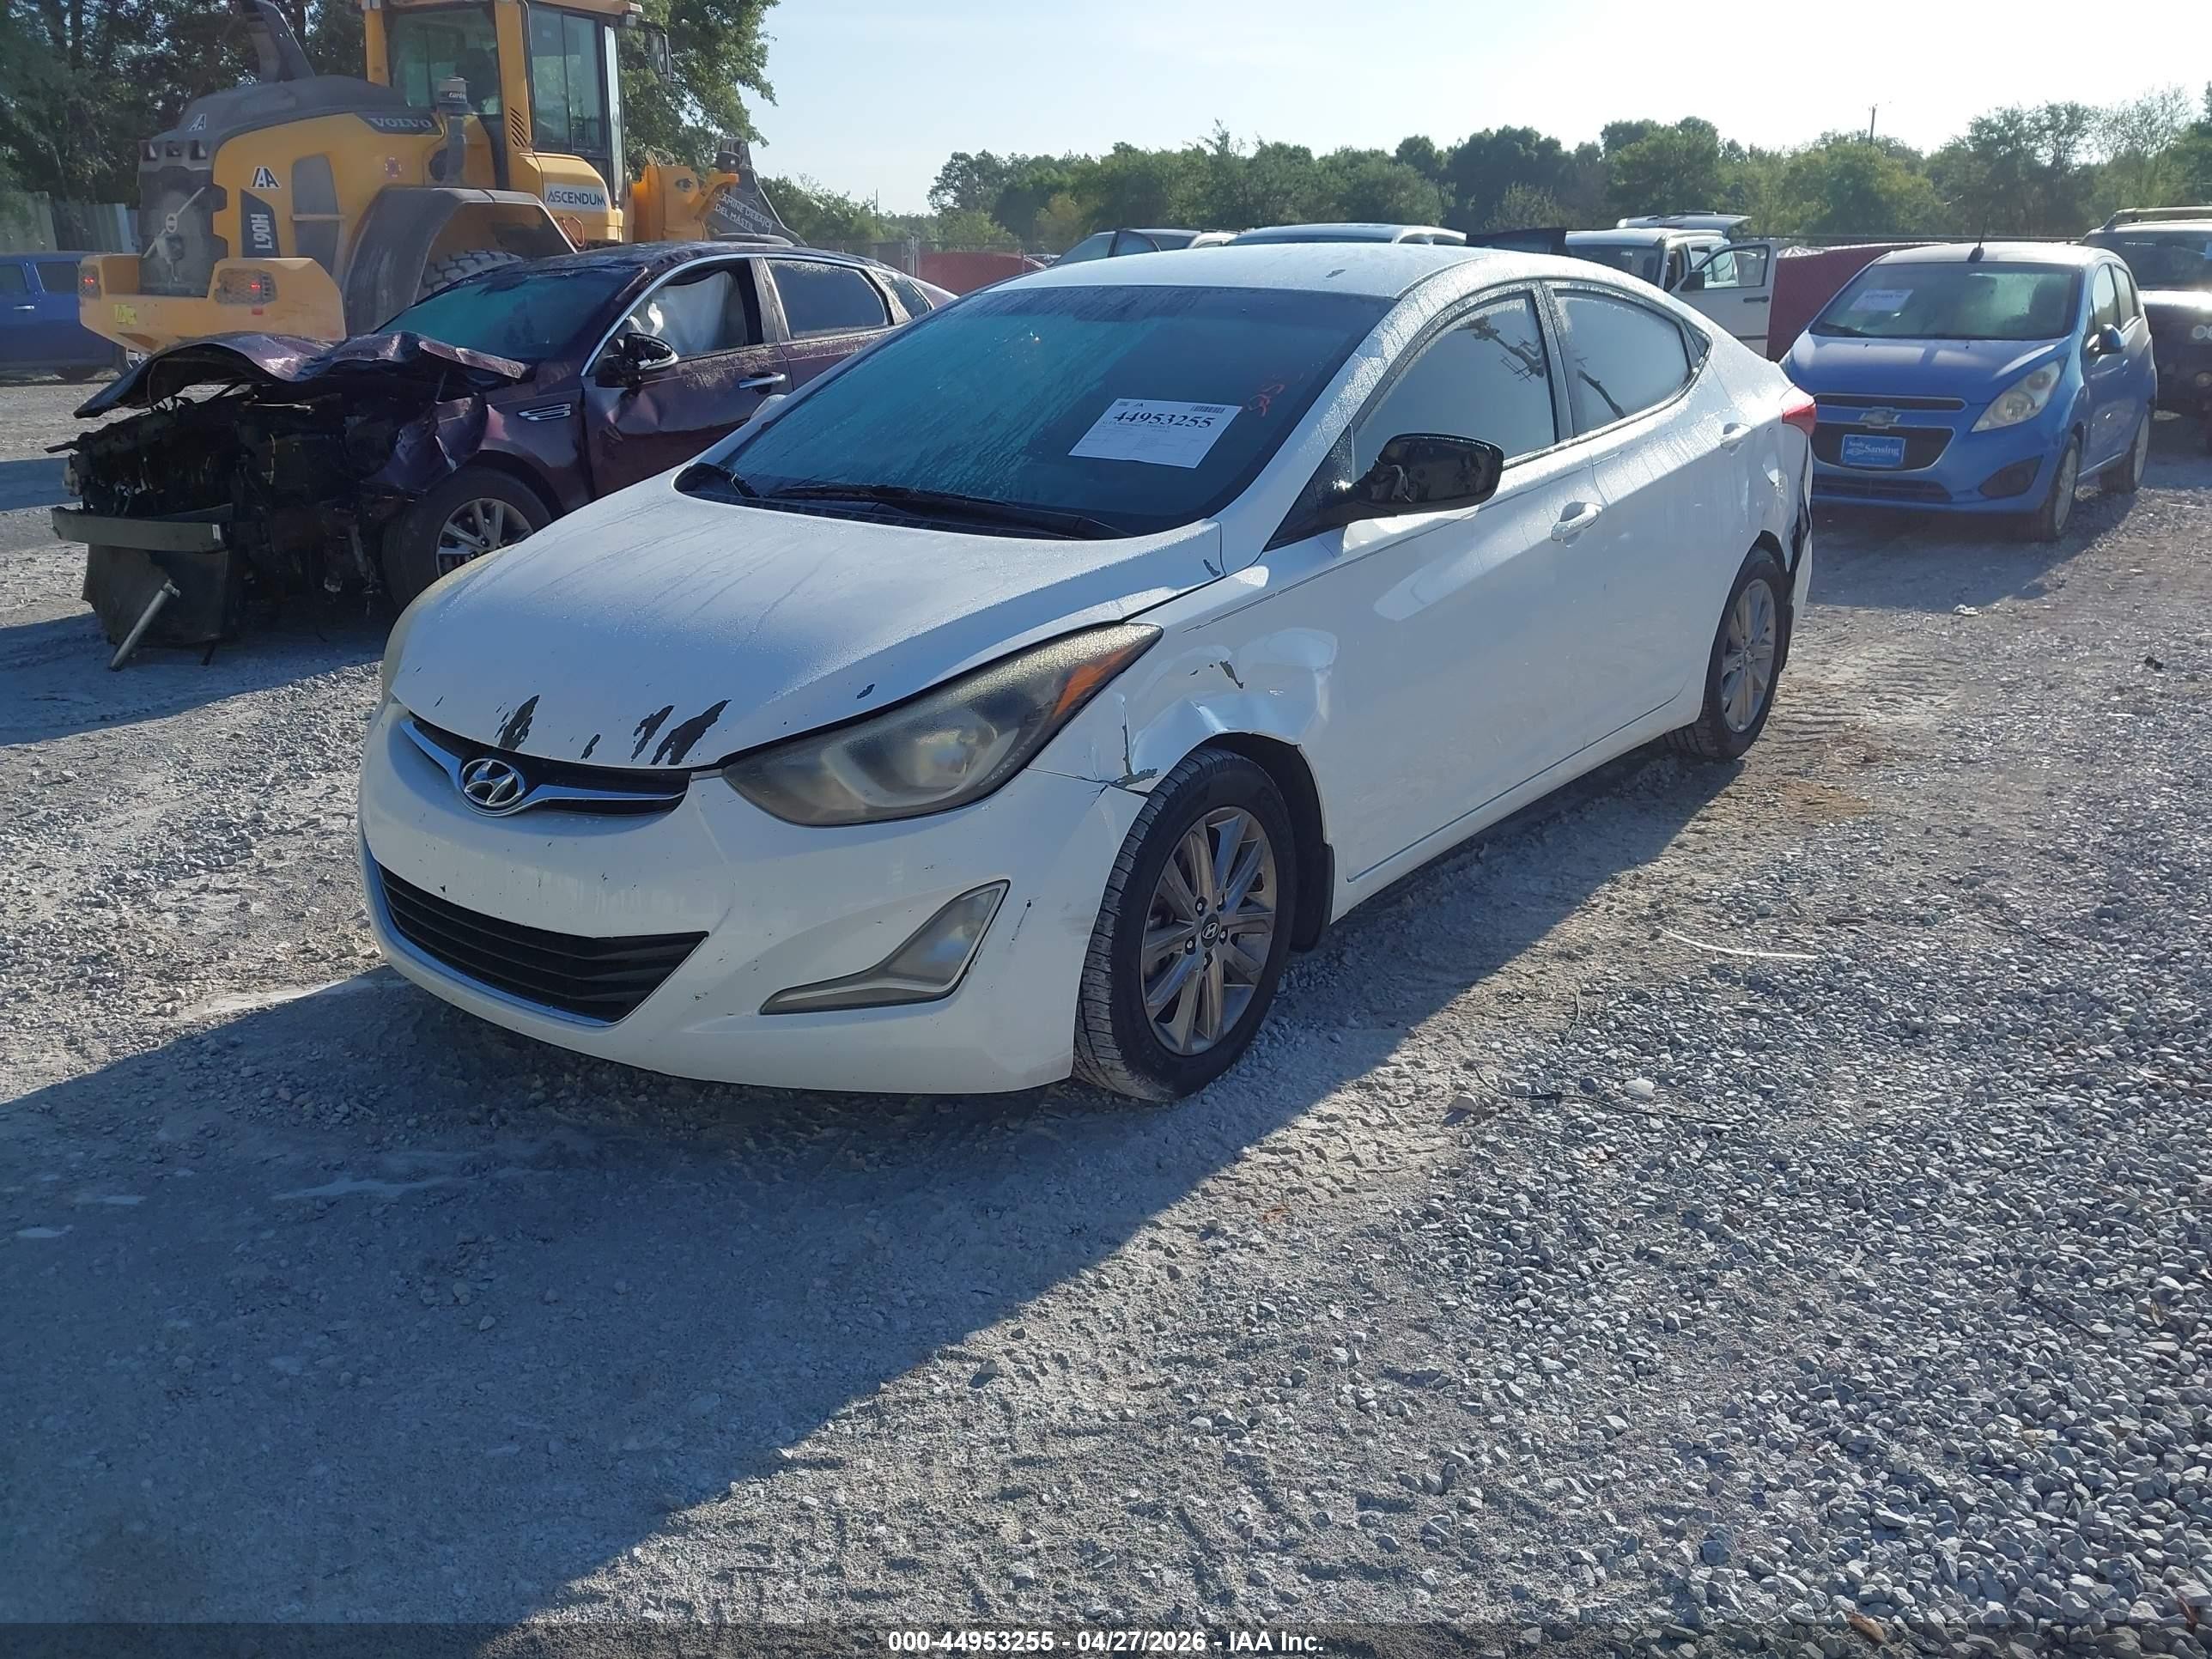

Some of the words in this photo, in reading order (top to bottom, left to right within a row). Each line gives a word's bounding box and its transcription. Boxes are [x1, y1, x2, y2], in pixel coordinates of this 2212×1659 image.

[368, 117, 433, 128] VOLVO
[547, 190, 606, 206] ASCENDUM
[250, 213, 273, 249] L90H
[1113, 410, 1215, 428] 44953255
